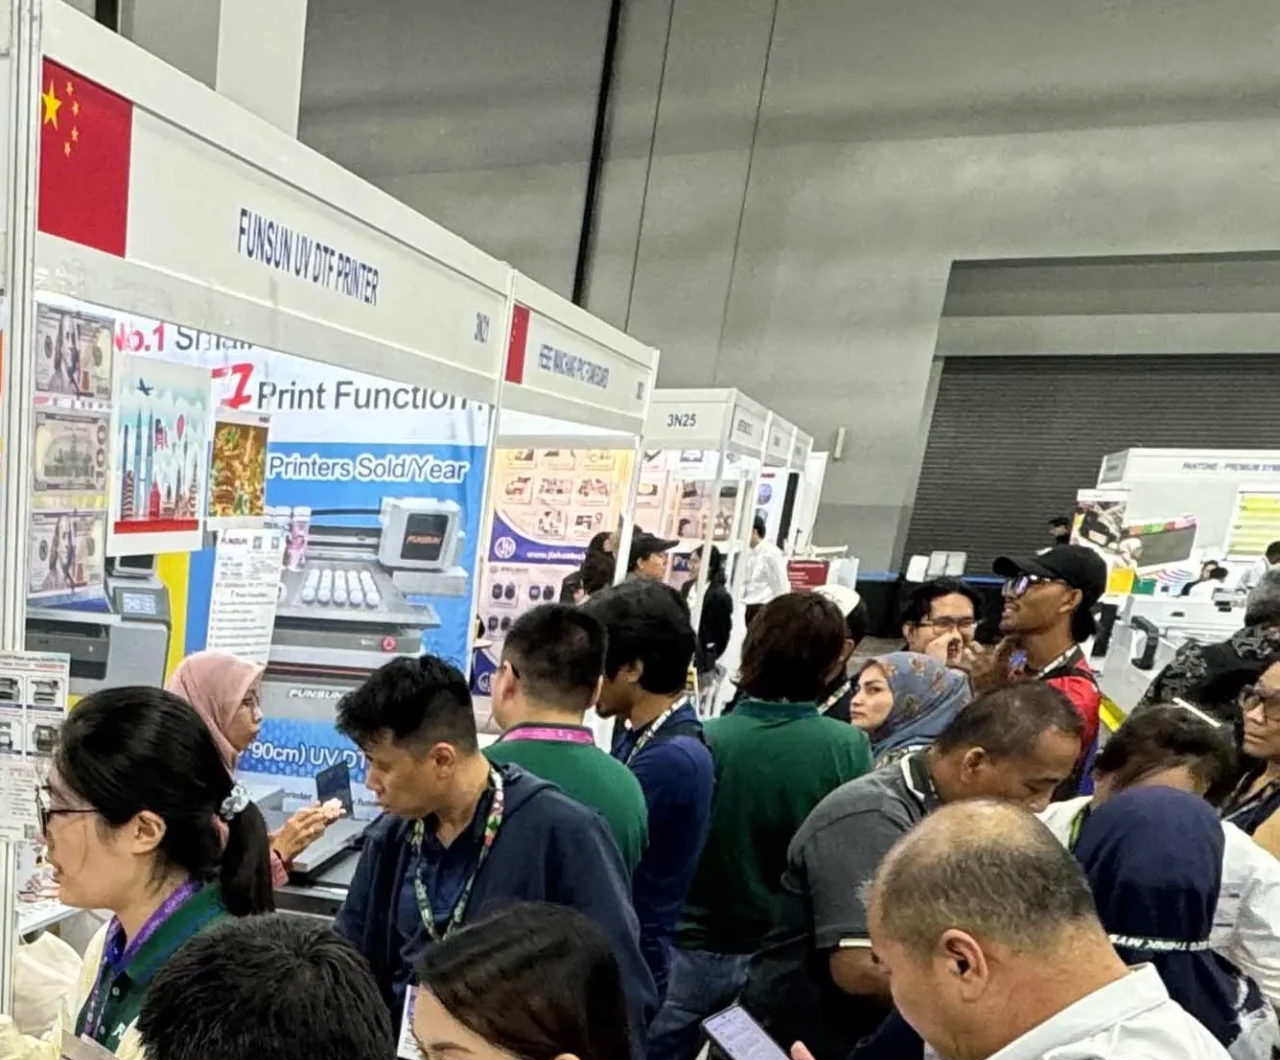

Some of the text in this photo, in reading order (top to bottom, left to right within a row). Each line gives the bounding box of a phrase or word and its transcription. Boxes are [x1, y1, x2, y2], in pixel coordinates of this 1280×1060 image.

[238, 207, 380, 306] FUNSUN UV DTF PRINTER
[258, 380, 325, 410] Print
[667, 414, 697, 428] 3N25
[270, 456, 467, 481] Printers Sold/Year
[310, 748, 341, 766] UV
